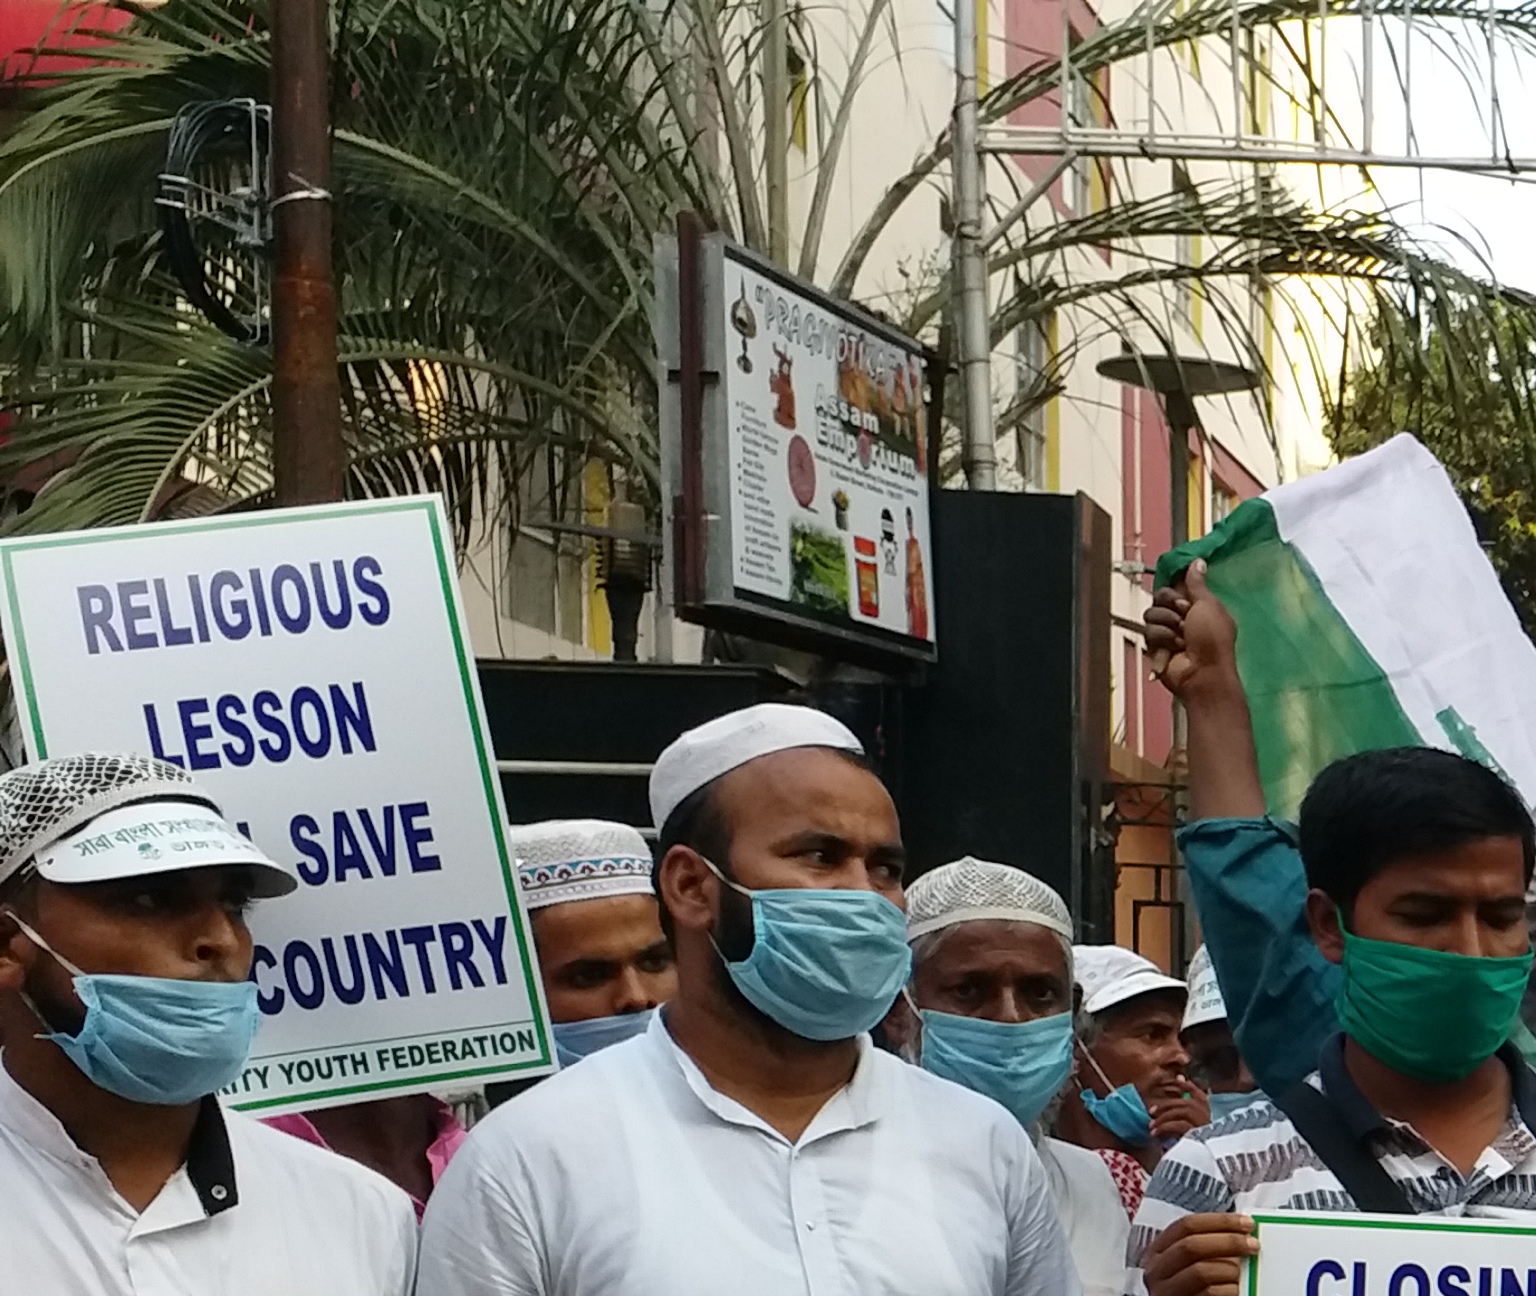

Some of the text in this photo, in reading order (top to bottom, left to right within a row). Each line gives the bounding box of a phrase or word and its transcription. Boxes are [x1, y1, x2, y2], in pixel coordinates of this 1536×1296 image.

[76, 556, 391, 654] RELIGIOUS
[142, 681, 378, 771] LESSON
[290, 802, 442, 886] SAVE
[248, 916, 509, 1015] COUNTRY
[278, 1051, 371, 1086] YOUTH
[378, 1031, 535, 1071] FEDERATION
